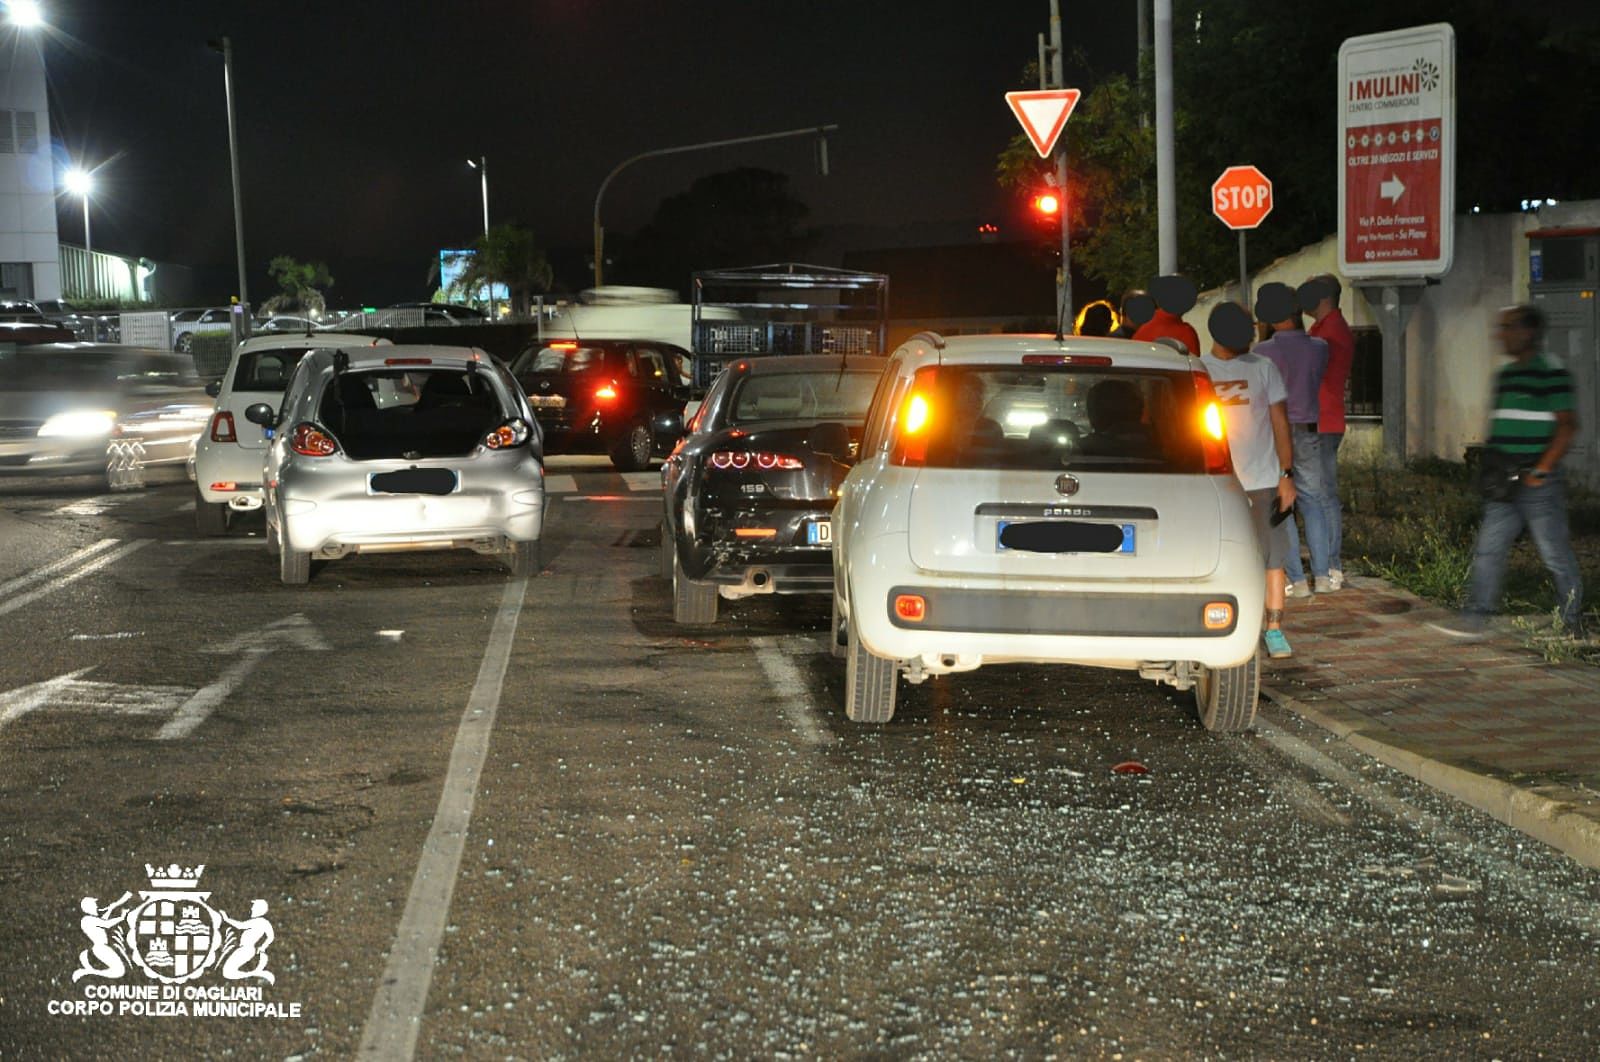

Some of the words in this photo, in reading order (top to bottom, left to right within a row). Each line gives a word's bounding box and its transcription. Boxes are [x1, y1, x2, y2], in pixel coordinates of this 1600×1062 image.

[1349, 81, 1354, 101] I
[1356, 73, 1420, 100] MULINI
[1349, 102, 1373, 113] CENTRO
[1374, 96, 1420, 110] COMMERCIALE
[1412, 148, 1438, 161] SERVIZI
[1217, 184, 1269, 211] STOP
[1394, 214, 1425, 225] Francesca
[740, 484, 765, 493] 159
